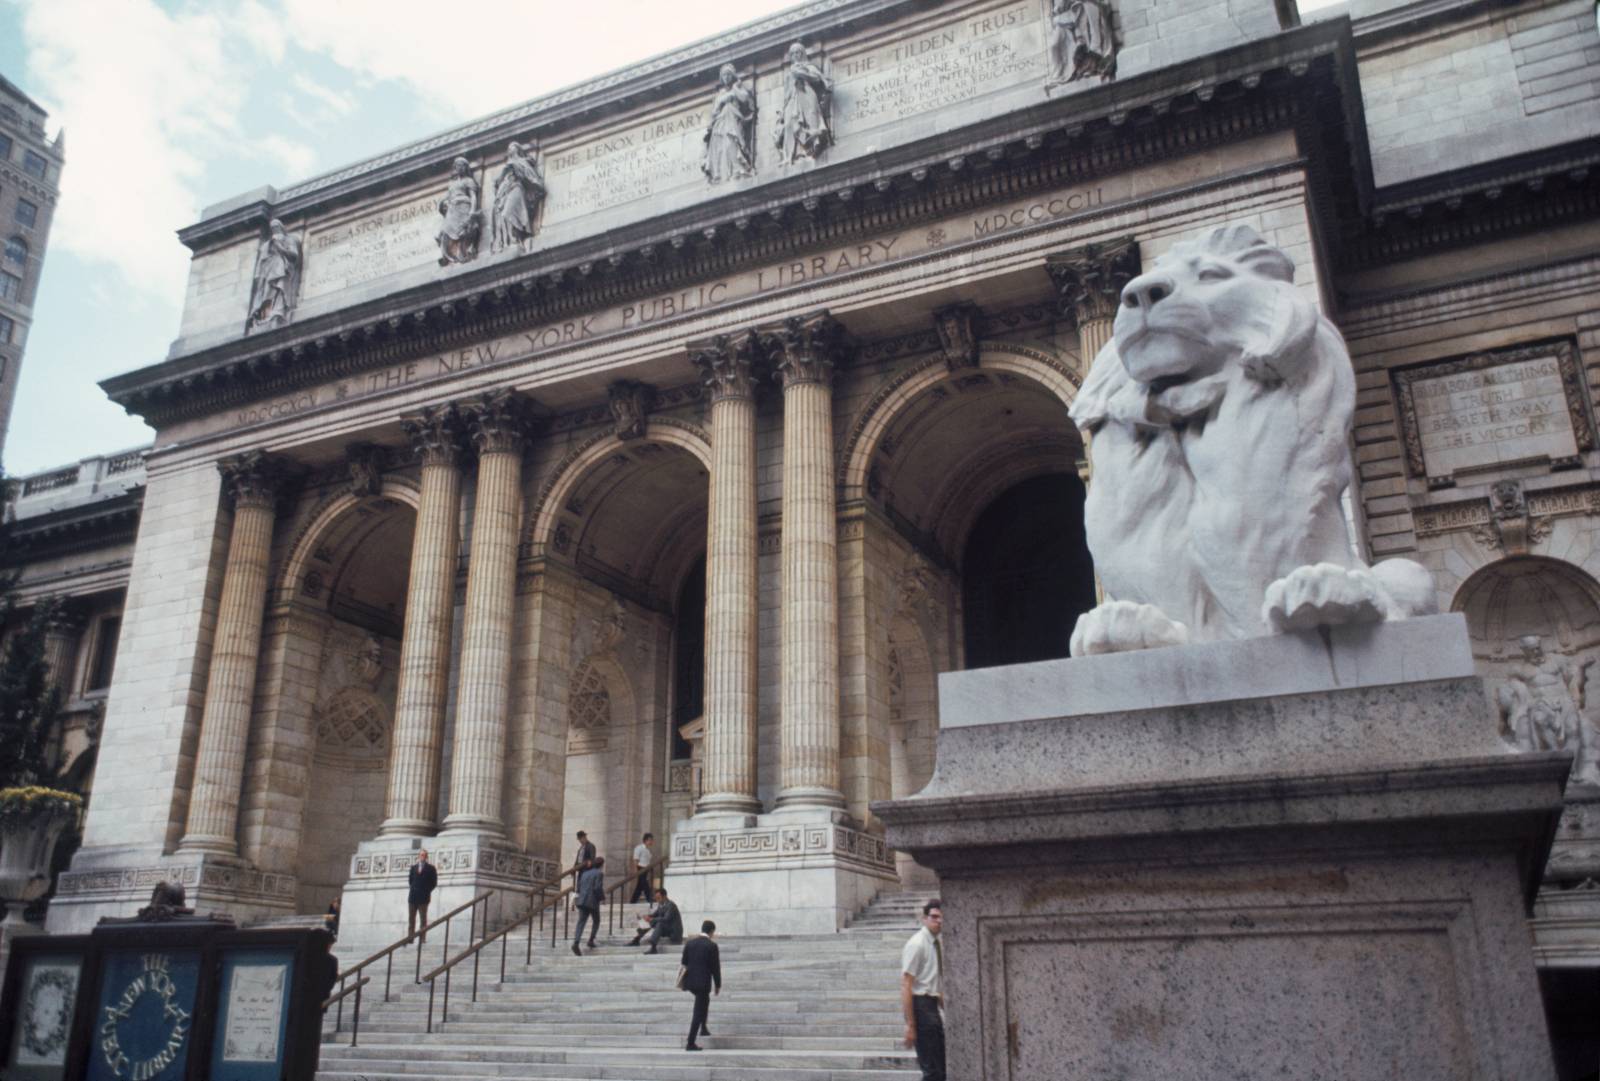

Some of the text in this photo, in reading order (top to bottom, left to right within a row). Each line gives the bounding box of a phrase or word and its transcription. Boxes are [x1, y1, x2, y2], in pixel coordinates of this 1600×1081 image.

[844, 6, 1029, 77] THE TILDEN TRUST
[958, 45, 971, 56] BY
[863, 42, 1011, 97] SAMUEL JONES TILDEN
[913, 78, 931, 91] THE
[1003, 51, 1017, 63] OF
[893, 96, 915, 109] AND
[552, 111, 705, 172] THE LENOX LIBRARY
[586, 151, 669, 184] JAMES LENOX
[318, 233, 338, 250] THE
[348, 217, 384, 239] ASTOR
[389, 198, 440, 225] LIBRARY
[367, 363, 418, 393] THE
[438, 342, 502, 376] NEW
[523, 316, 598, 353] YORK
[620, 282, 728, 329] PUBLIC
[757, 237, 899, 293] LIBRARY
[973, 188, 1104, 238] MDCCCCII
[1440, 373, 1481, 395] ABOVE
[1502, 363, 1557, 385] THINGS
[1432, 399, 1553, 432] BEARETH AWAY
[1458, 388, 1514, 409] TRUTH
[1444, 418, 1549, 447] THE VICTORY
[140, 953, 170, 974] THE
[118, 971, 179, 1020] NEW YORK
[100, 1005, 191, 1081] PUBLIC LIBRARY
